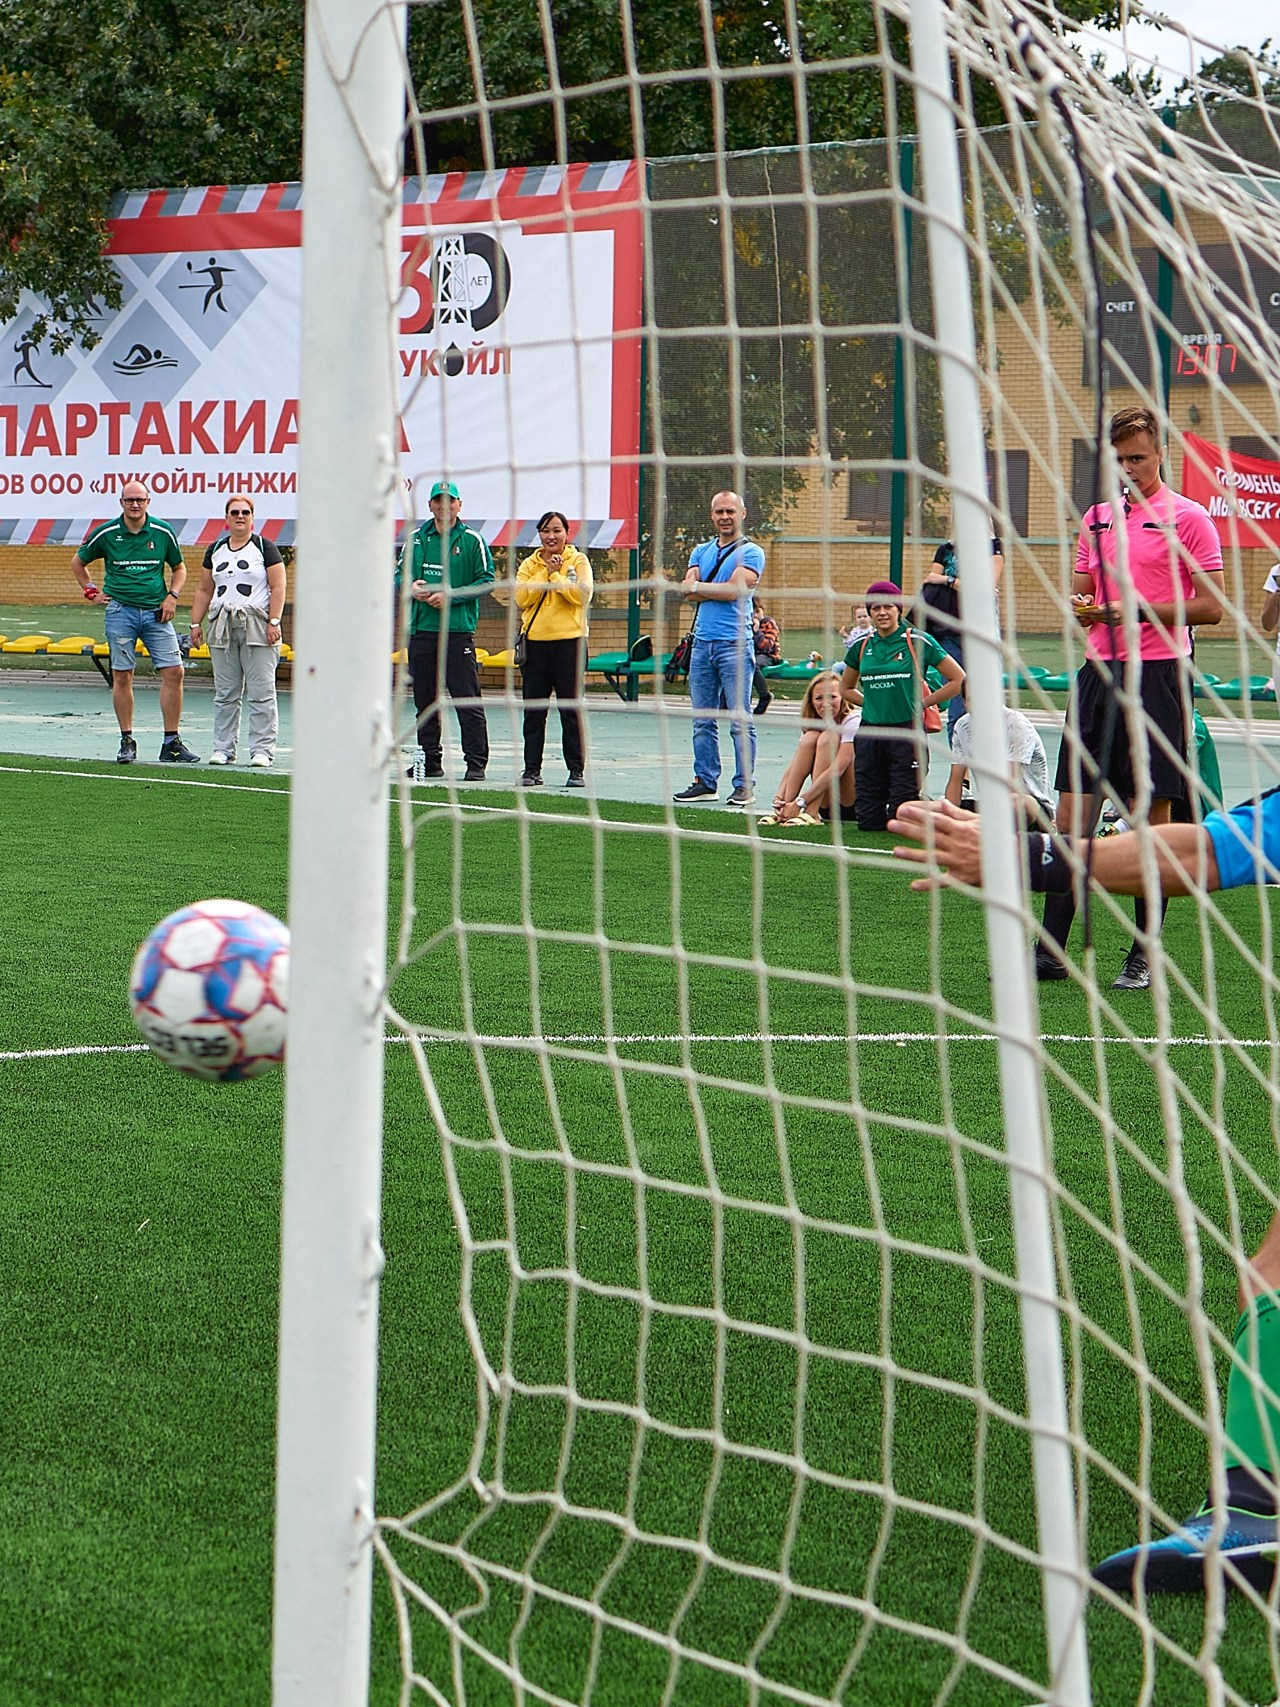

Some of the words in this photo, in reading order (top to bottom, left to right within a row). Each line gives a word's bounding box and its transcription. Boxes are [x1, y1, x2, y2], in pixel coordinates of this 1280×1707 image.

[470, 275, 489, 286] ЛЕТ
[1106, 301, 1136, 312] СЧЕТ
[1183, 333, 1222, 345] ВРЕМЯ
[399, 341, 511, 377] УКОЙЛ
[1176, 344, 1237, 375] 13:07
[30, 473, 84, 495] ООО
[869, 681, 896, 689] МОСКВА
